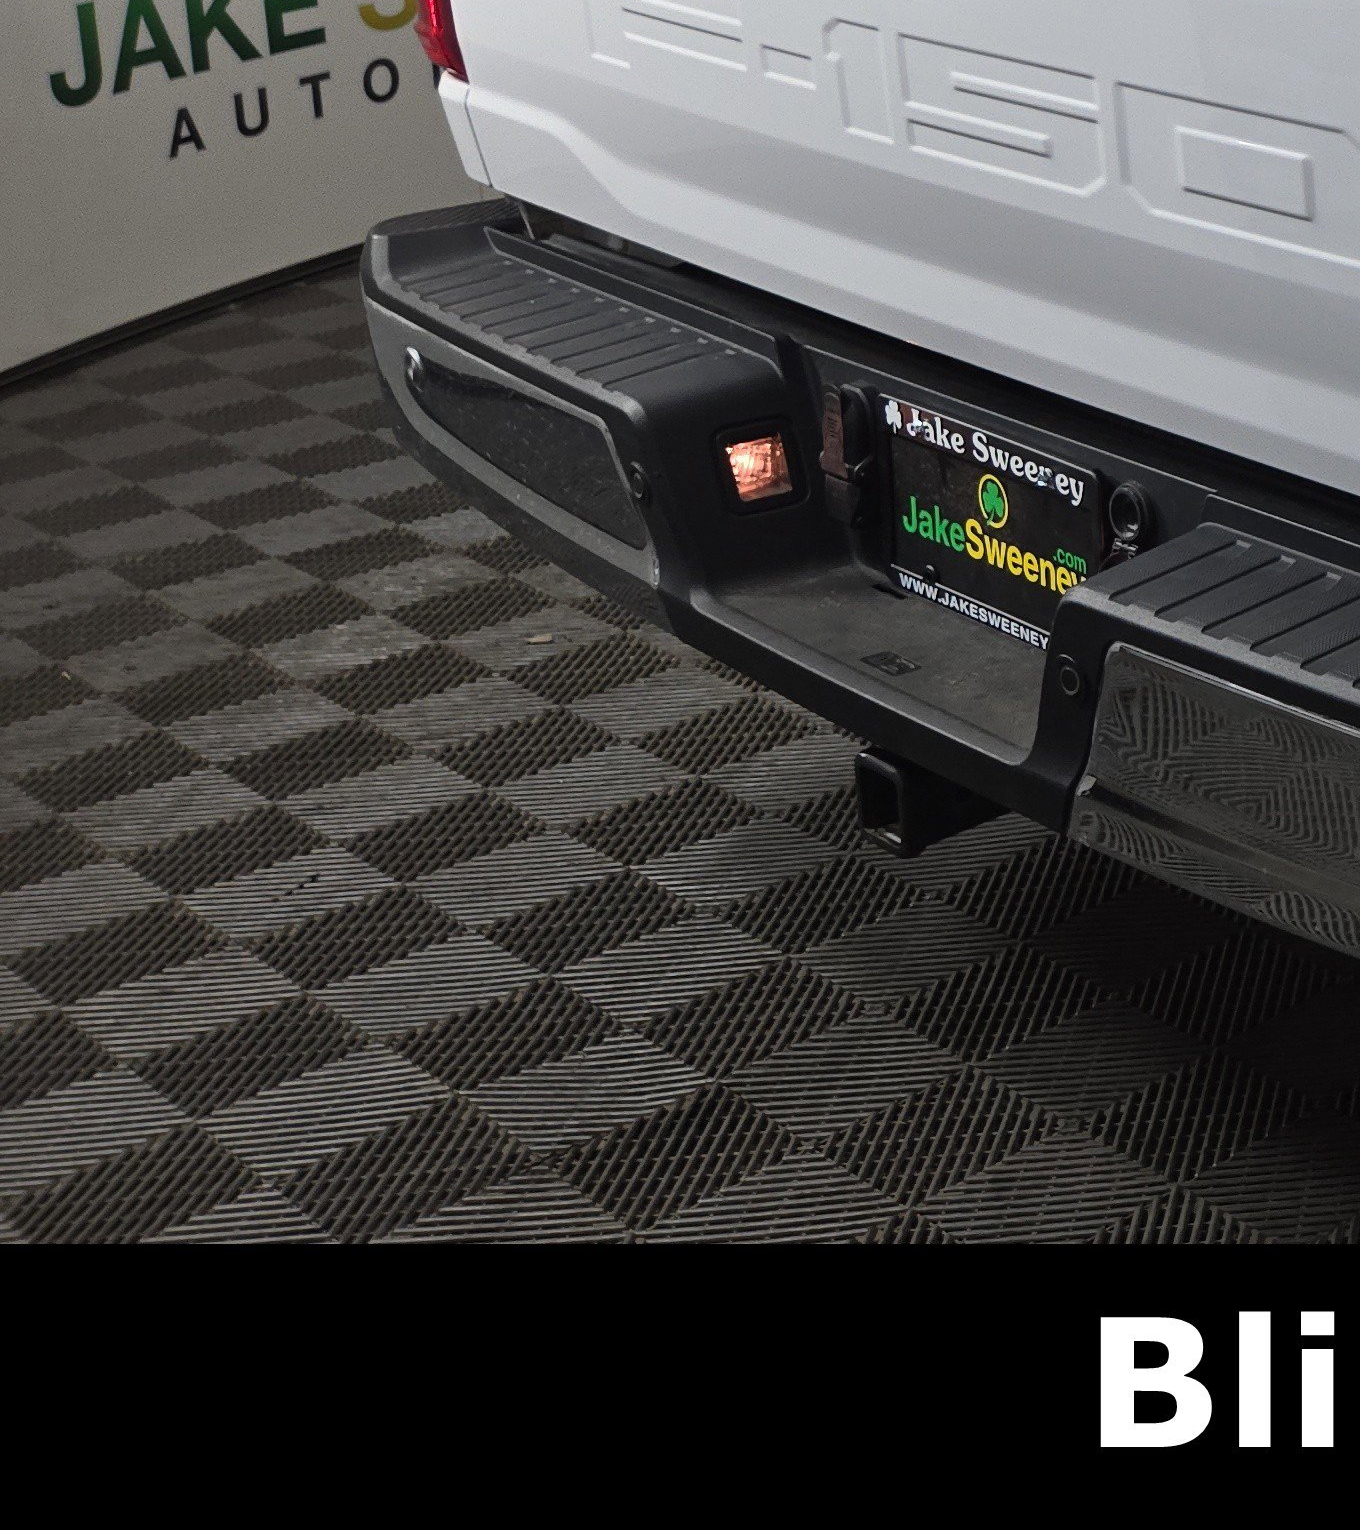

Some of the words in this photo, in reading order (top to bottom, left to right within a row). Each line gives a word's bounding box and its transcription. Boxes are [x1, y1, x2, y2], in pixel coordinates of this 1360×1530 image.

[906, 407, 965, 454] Jake
[1053, 548, 1087, 574] .com
[899, 573, 1049, 650] WWW.JAKESWEENEY
